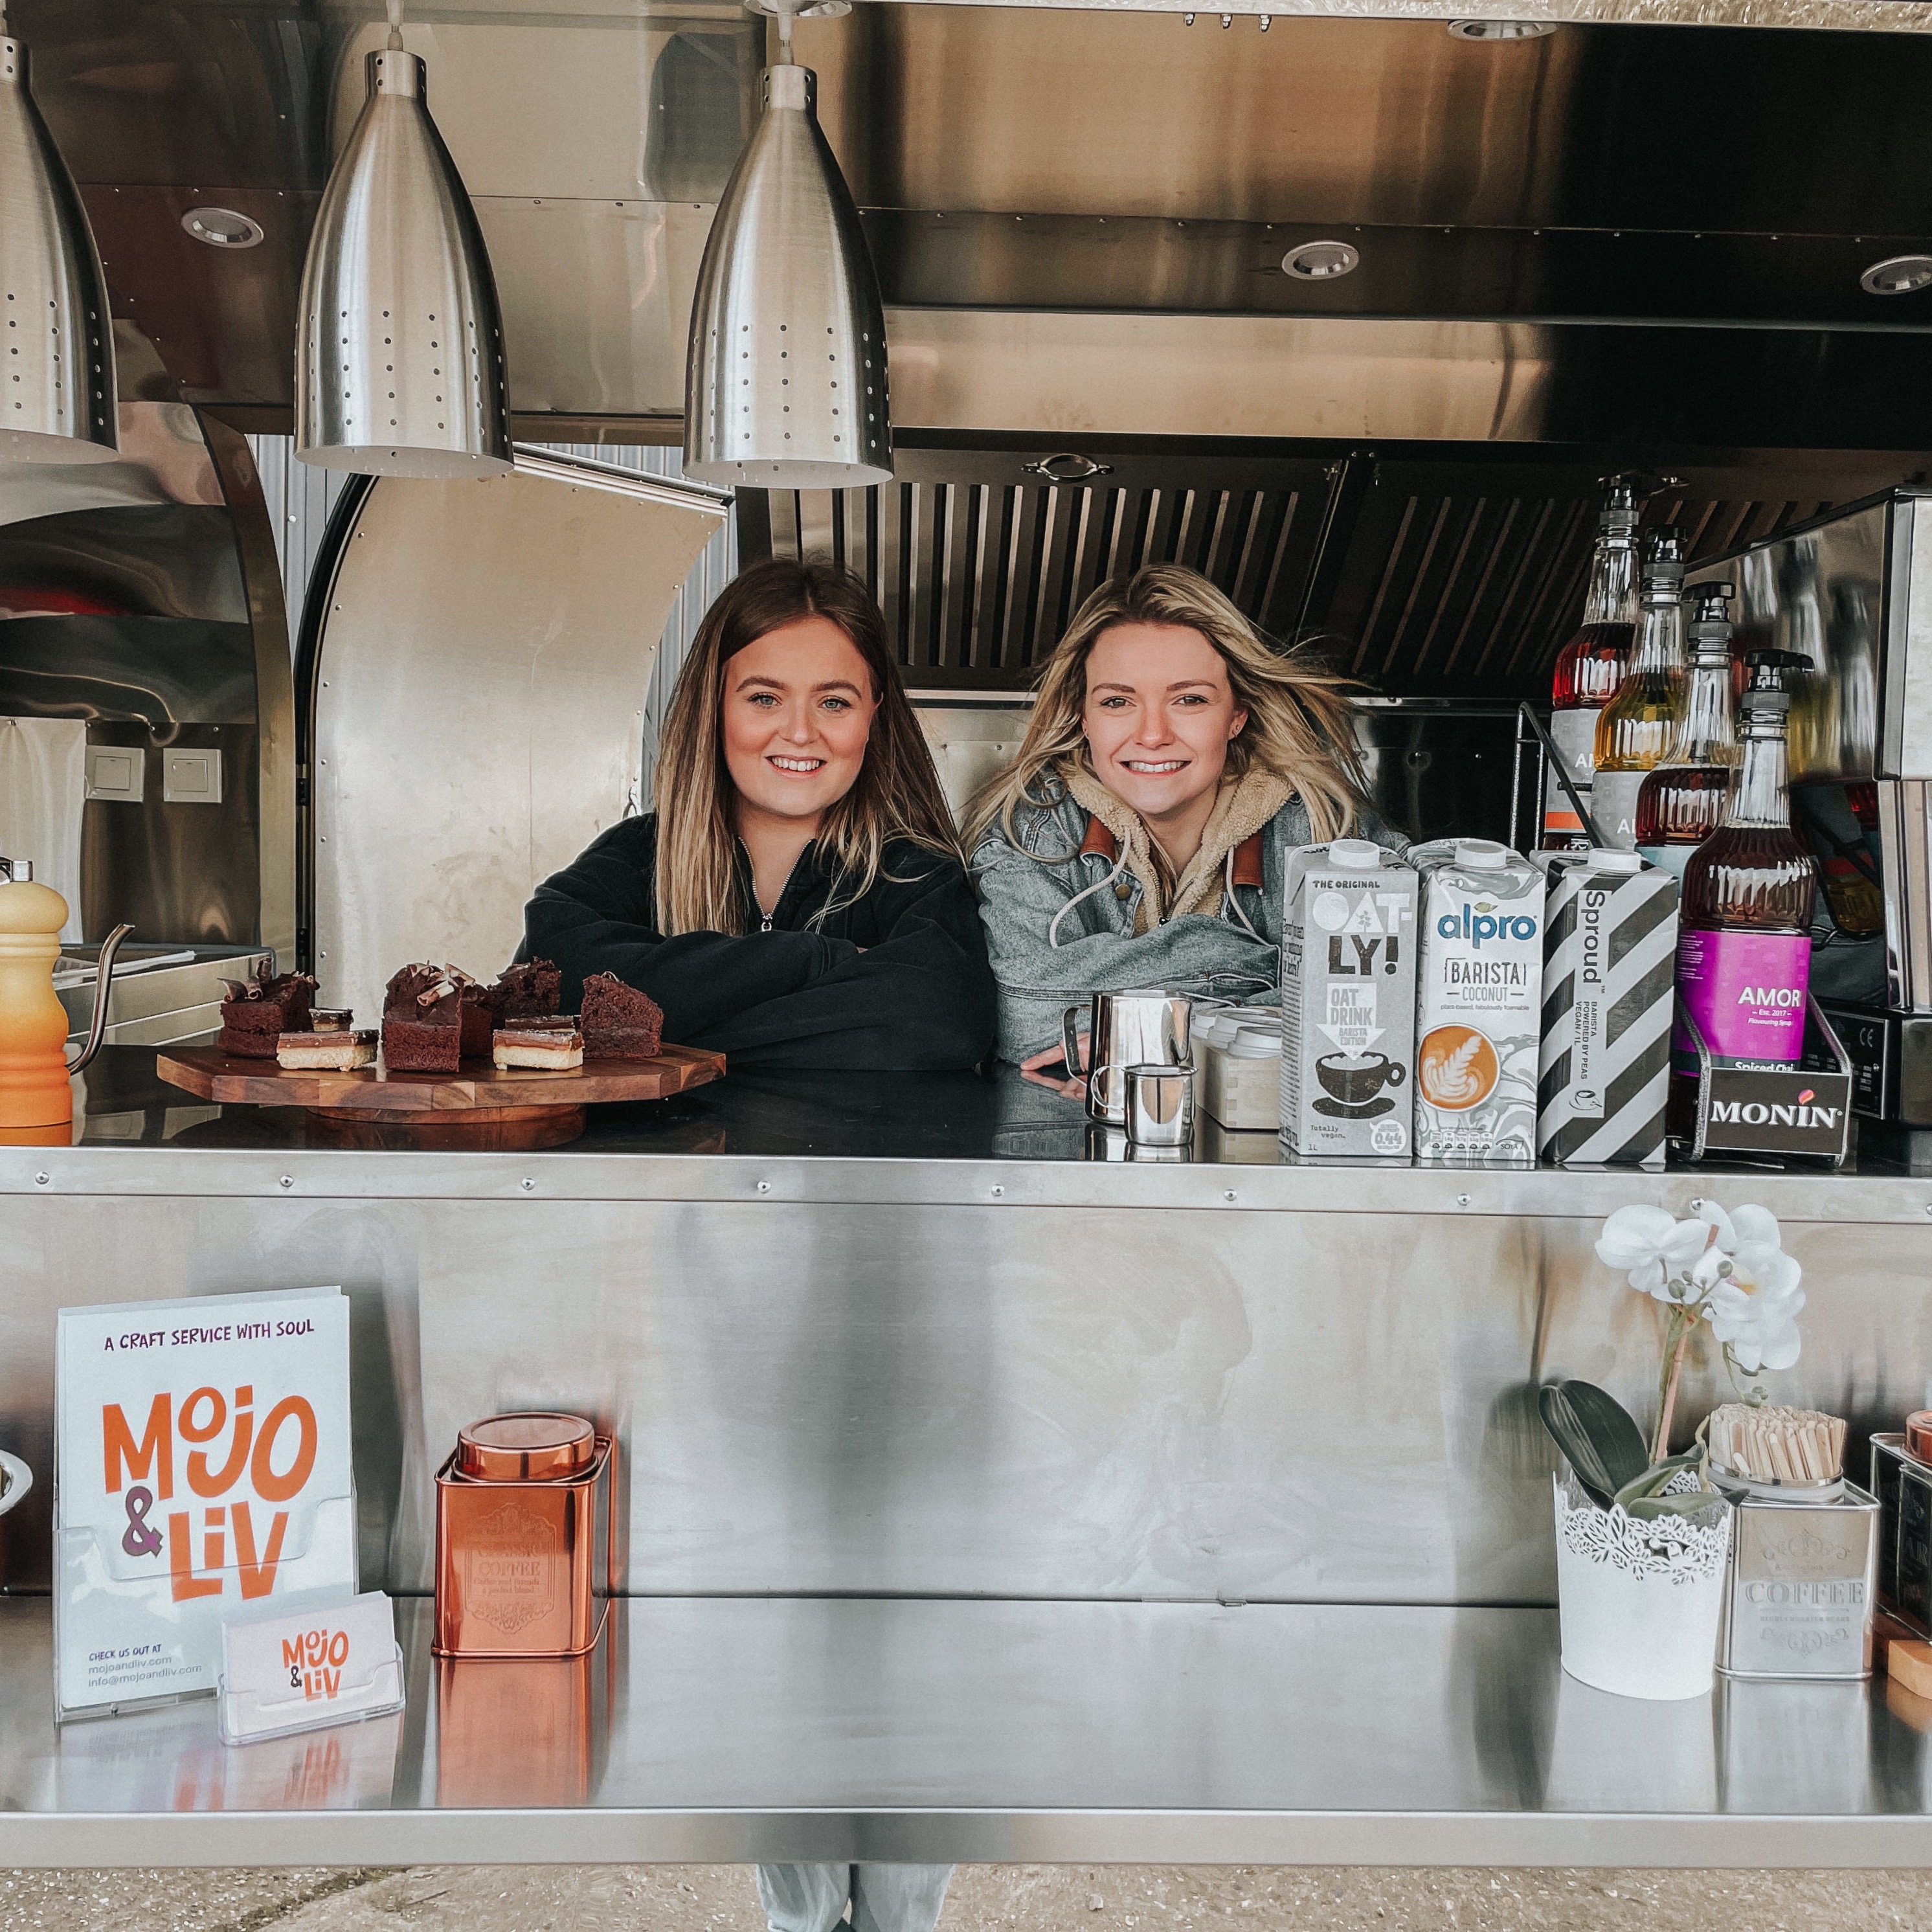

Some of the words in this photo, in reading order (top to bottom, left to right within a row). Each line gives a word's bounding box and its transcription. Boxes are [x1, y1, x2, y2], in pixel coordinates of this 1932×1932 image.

[1438, 903, 1536, 949] alpro
[1581, 891, 1605, 983] Sproud
[1329, 935, 1398, 975] LY!
[1452, 962, 1520, 984] BARISTA
[1331, 988, 1359, 1007] OAT
[1463, 987, 1508, 1002] COCONUT
[1738, 987, 1802, 1007] AMOR
[1331, 1007, 1373, 1026] DRINK
[1582, 1044, 1589, 1056] BY
[1710, 1101, 1838, 1129] MONIN
[1375, 1133, 1402, 1144] 0.44
[104, 1336, 114, 1351] A
[120, 1331, 165, 1349] CRAFT
[171, 1326, 232, 1345] SERVICE
[237, 1321, 271, 1340] WITH
[276, 1319, 315, 1336] SOUL
[122, 1485, 163, 1557] &
[479, 1561, 541, 1576] COFFEE
[1746, 1582, 1863, 1604] COFFEE
[89, 1650, 116, 1661] CHECK
[118, 1648, 130, 1657] US
[133, 1645, 150, 1655] OUT
[152, 1644, 162, 1653] AT
[89, 1656, 172, 1674] mojoandliv.com
[89, 1665, 202, 1687] info@mojoandliv.com
[291, 1665, 302, 1687] &
